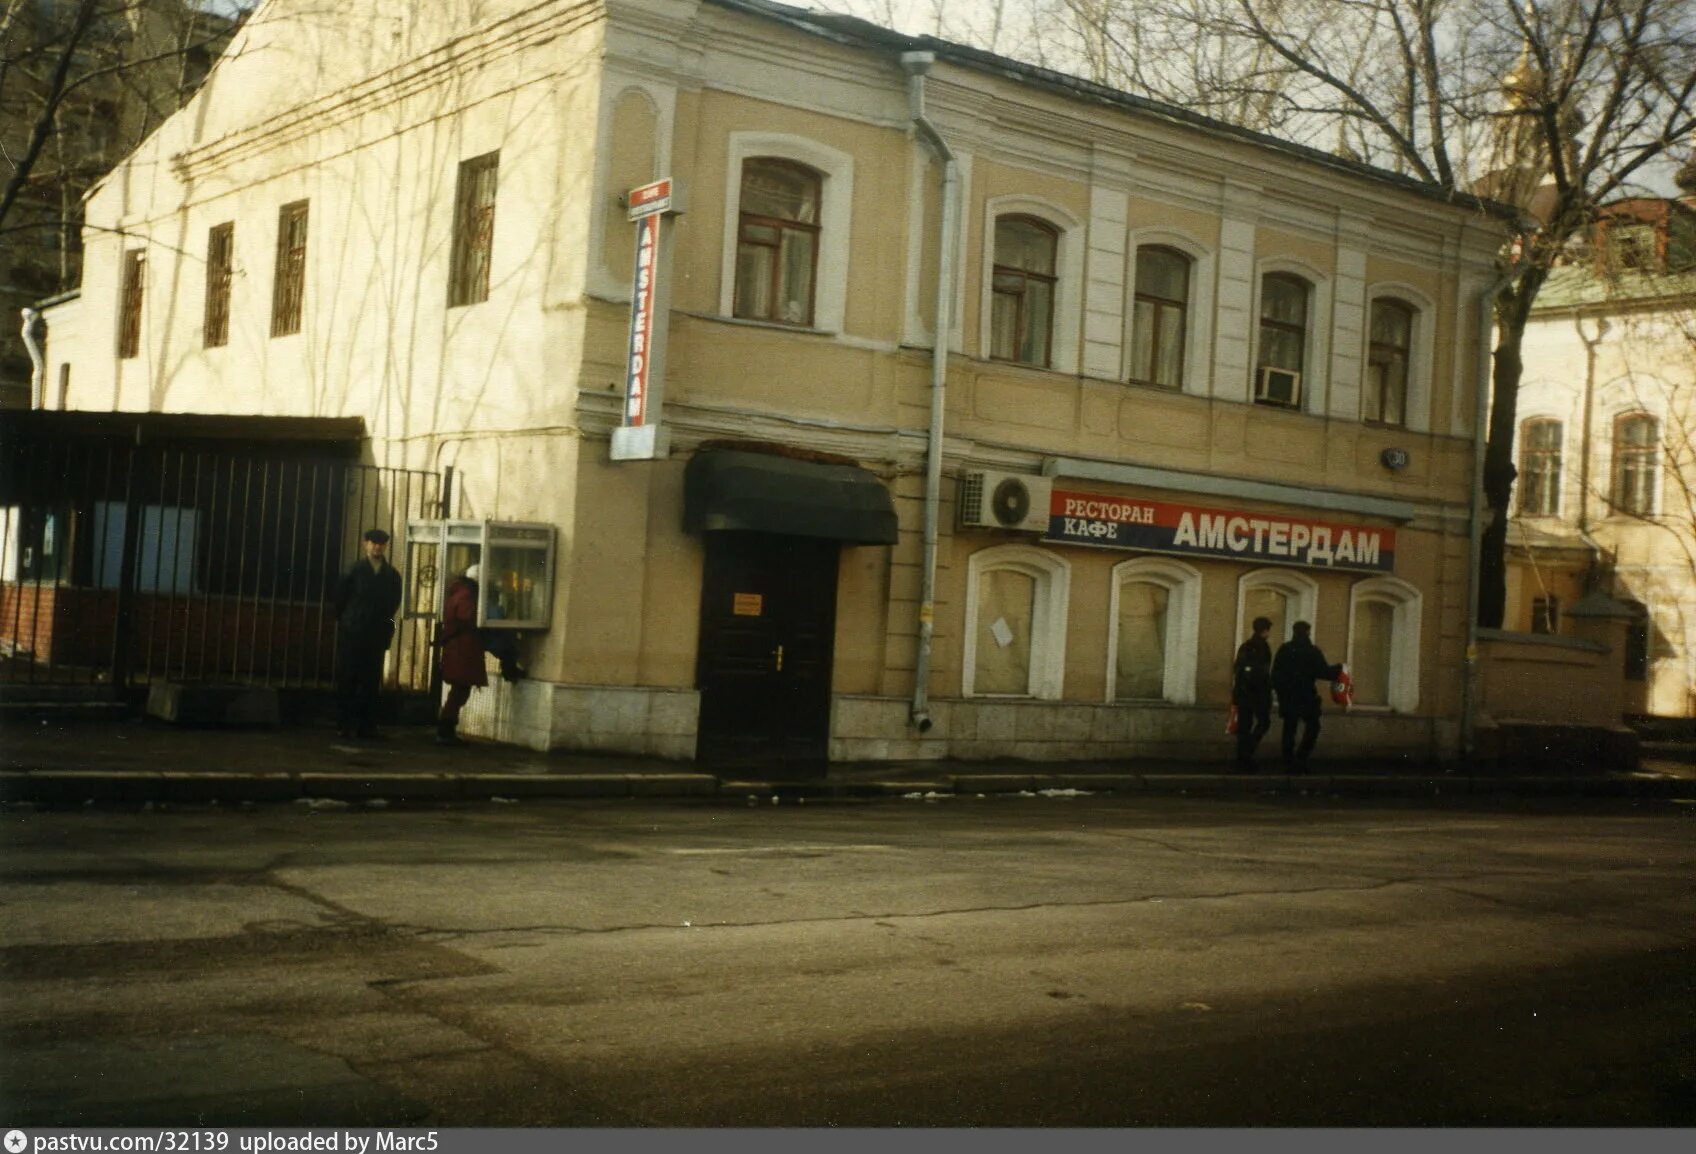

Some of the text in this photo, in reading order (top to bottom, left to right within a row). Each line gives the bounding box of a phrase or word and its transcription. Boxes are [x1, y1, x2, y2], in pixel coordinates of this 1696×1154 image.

[1065, 498, 1154, 524] РЕСТОРАН
[1064, 517, 1118, 539] КАФЕ
[1173, 511, 1380, 567] АМСТЕРДАМ
